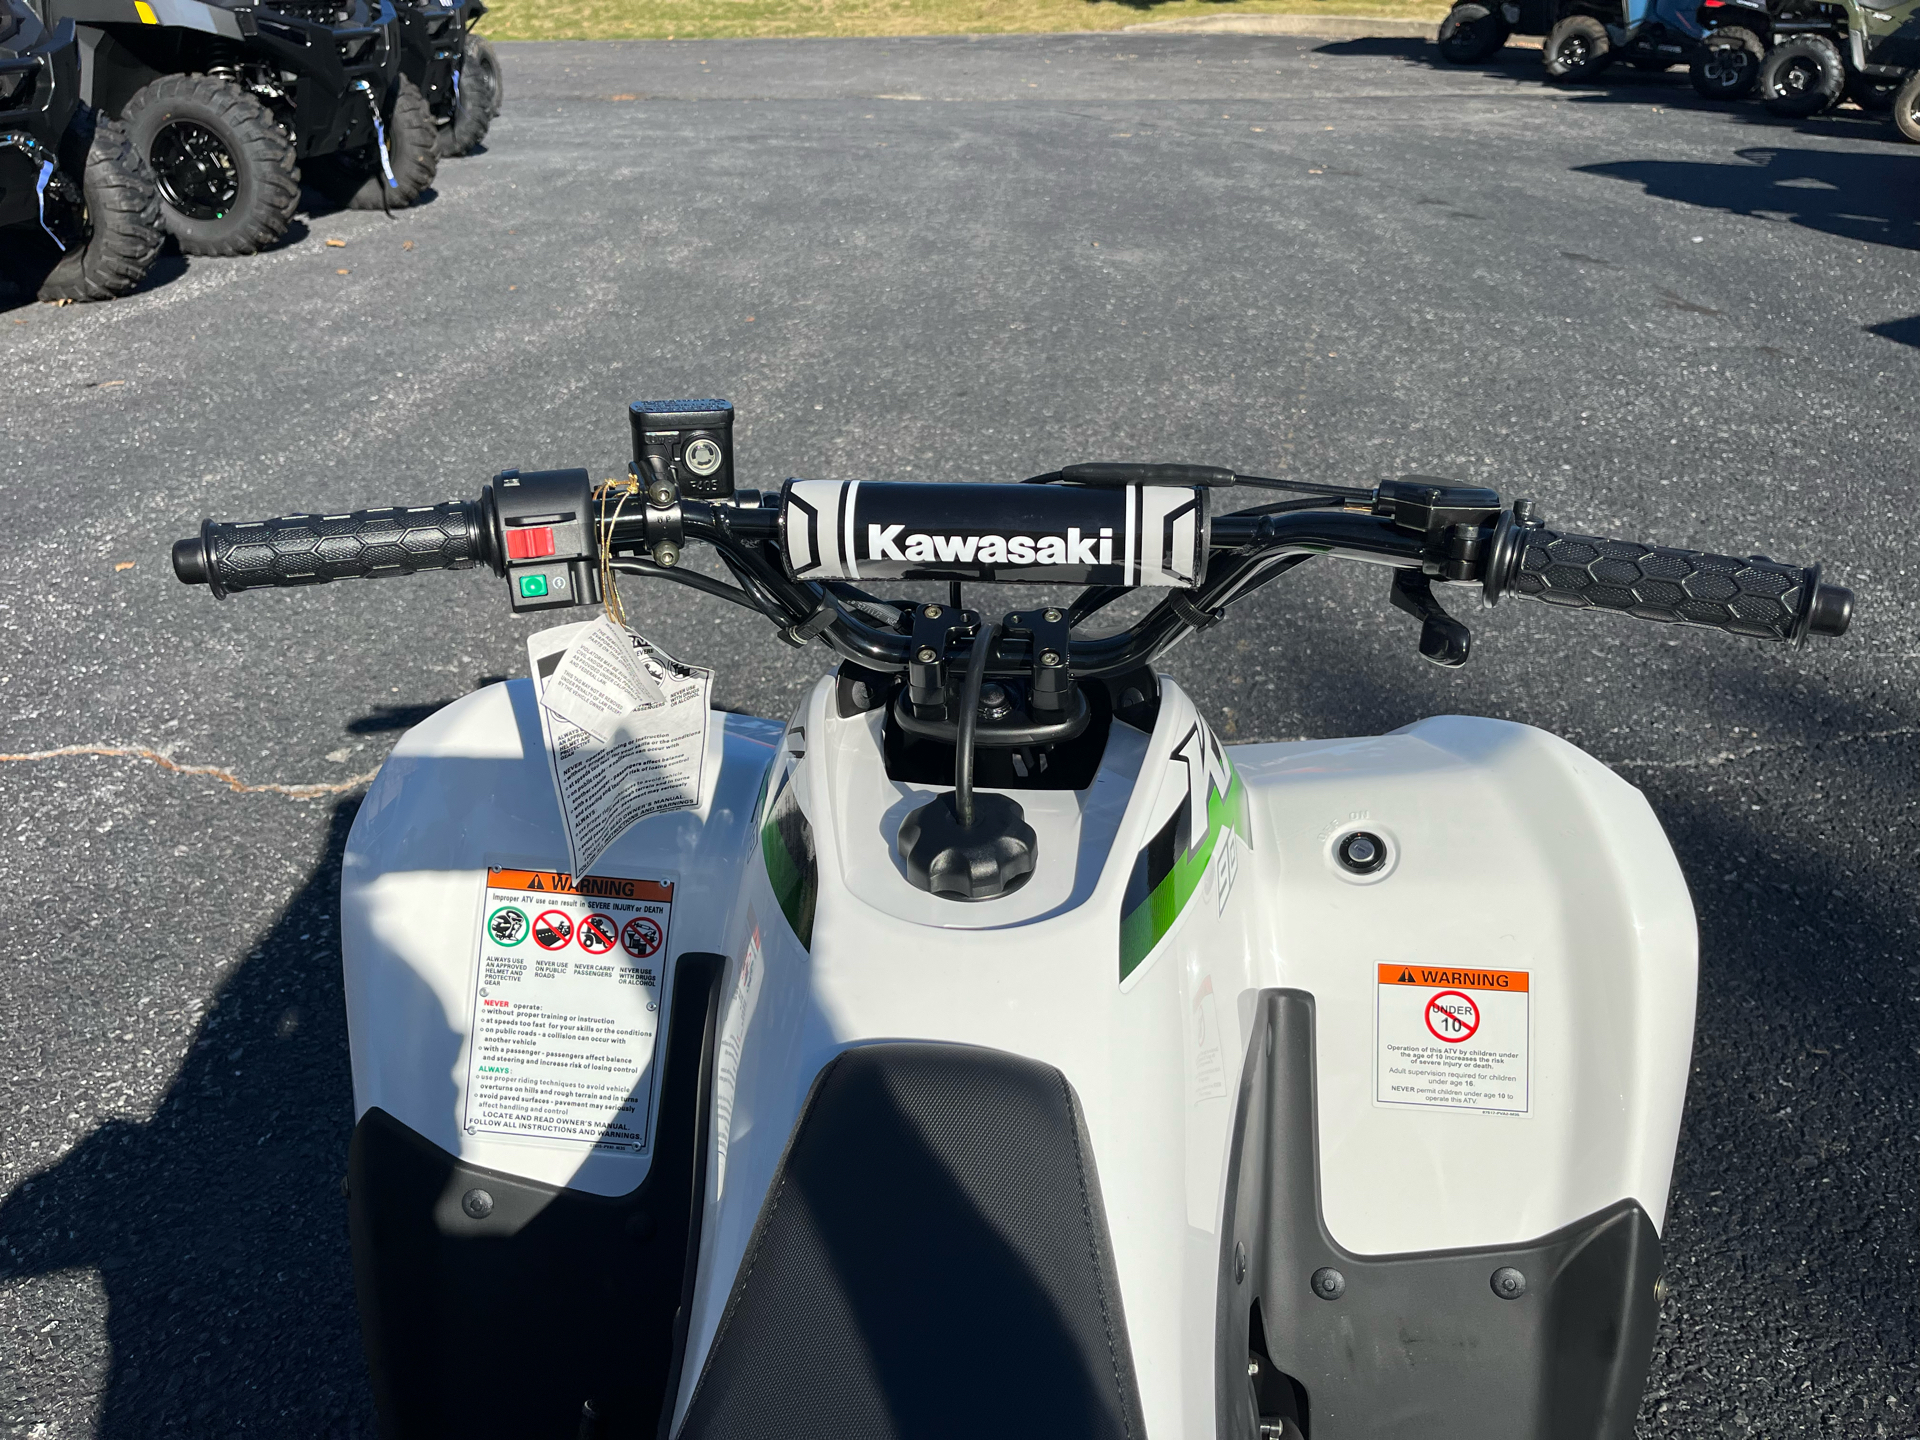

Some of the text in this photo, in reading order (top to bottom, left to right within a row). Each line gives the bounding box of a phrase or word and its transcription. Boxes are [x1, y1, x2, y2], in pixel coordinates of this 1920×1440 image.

[868, 523, 1114, 566] Kawasaki
[670, 689, 685, 698] NEVER
[678, 693, 700, 704] ALCOHOL
[492, 893, 519, 903] Improper
[612, 903, 634, 912] INJURY
[643, 906, 663, 914] DEATH
[573, 969, 612, 977] PASSENGERS
[628, 979, 657, 987] ALCOHOL
[1421, 970, 1509, 988] WARNING
[484, 999, 509, 1007] NEVER
[1432, 1005, 1473, 1016] UNDER
[540, 1012, 568, 1022] training
[577, 1015, 615, 1024] instruction
[1441, 1017, 1462, 1032] 10
[547, 1032, 576, 1040] collision
[616, 1029, 652, 1037] conditions
[505, 1047, 541, 1056] passenger
[545, 1051, 584, 1060] passengers
[606, 1055, 632, 1064] balance
[496, 1056, 525, 1065] steering
[539, 1058, 568, 1067] increase
[591, 1063, 612, 1072] losing
[1442, 1060, 1462, 1068] injury
[499, 1103, 529, 1112] handling
[482, 1111, 513, 1119] LOCATE
[533, 1115, 555, 1123] READ
[556, 1117, 592, 1127] OWNER'S
[469, 1117, 502, 1126] FOLLOW
[518, 1122, 577, 1134] INSTRUCTIONS
